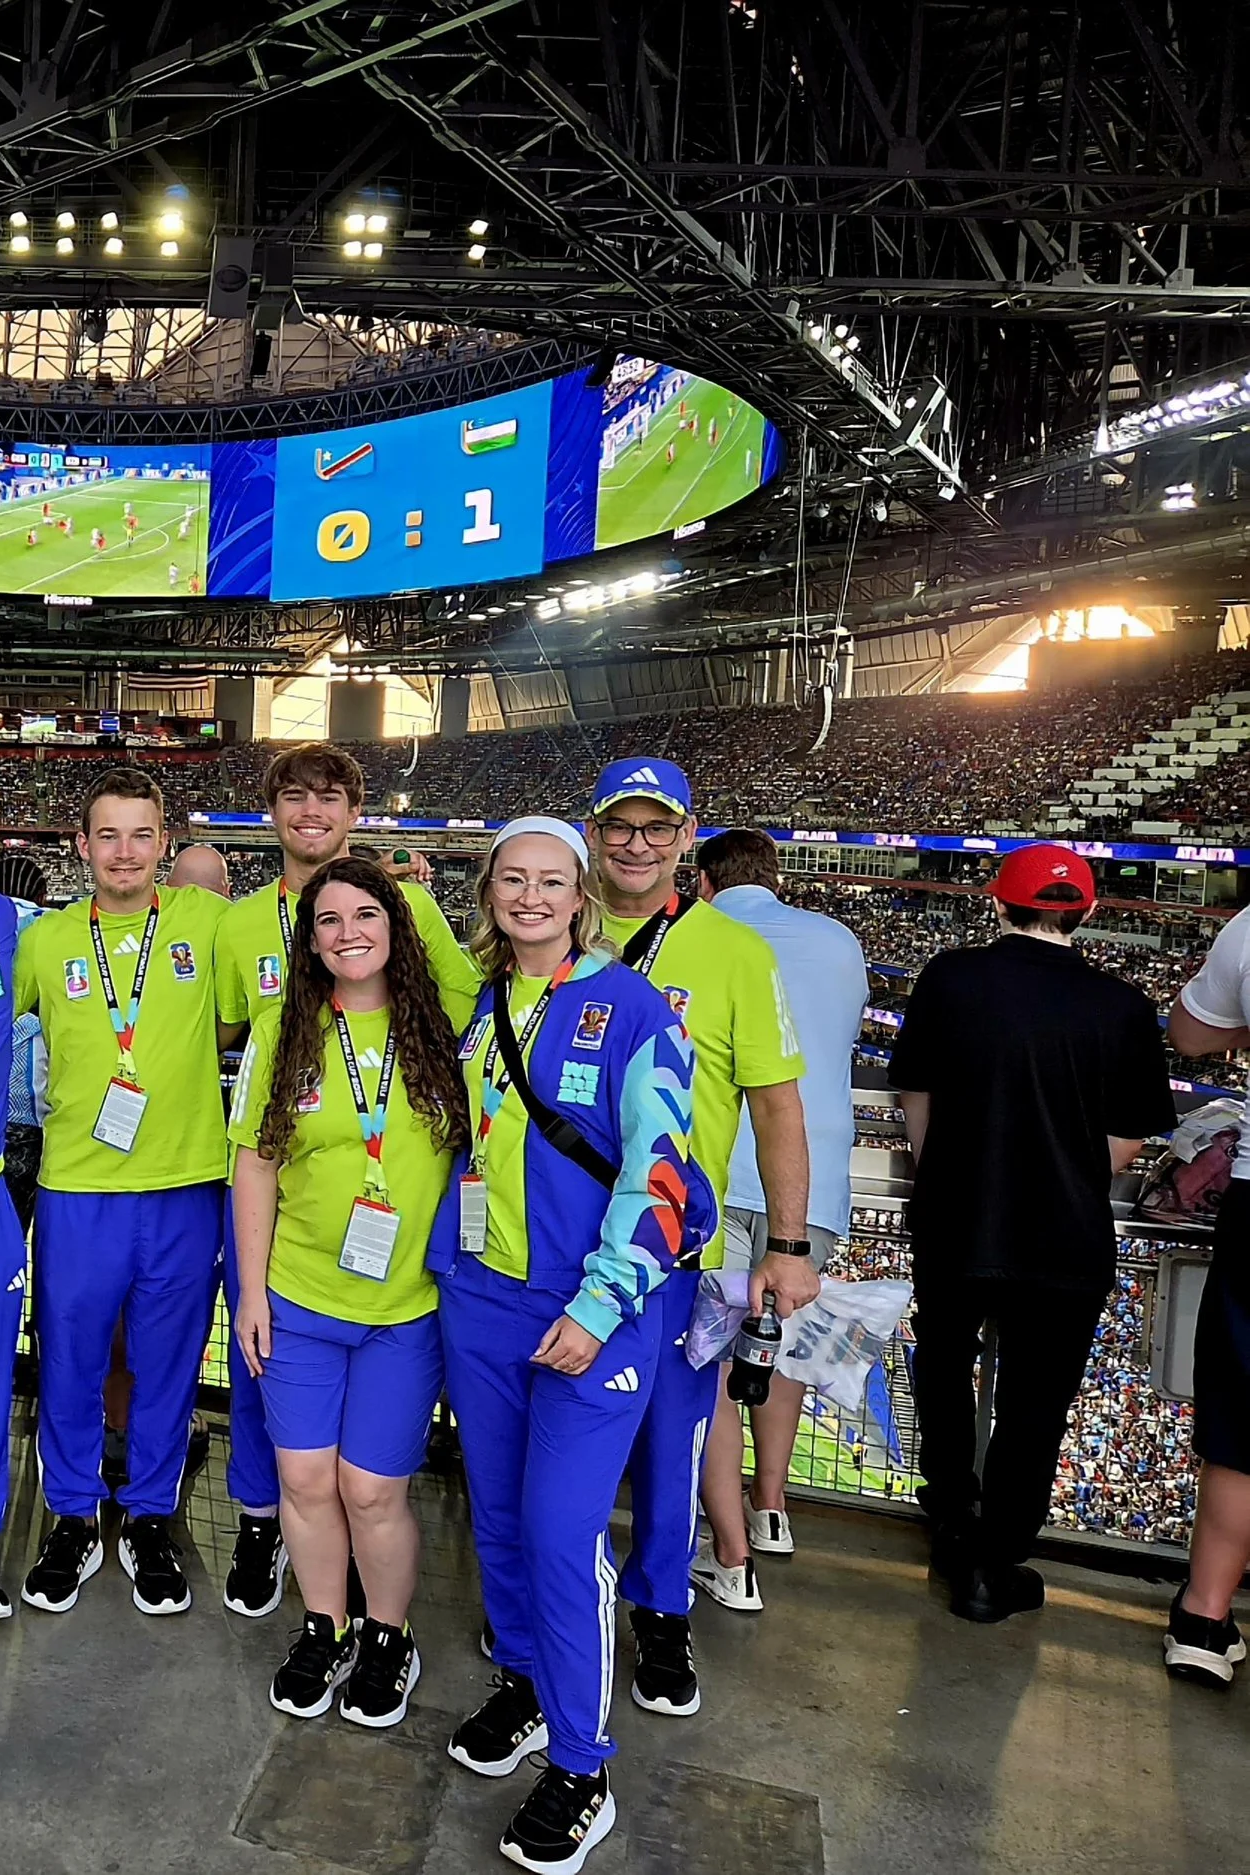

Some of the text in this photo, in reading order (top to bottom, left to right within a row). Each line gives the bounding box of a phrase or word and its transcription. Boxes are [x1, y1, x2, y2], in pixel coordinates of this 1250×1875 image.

[316, 509, 371, 562] 0
[462, 488, 501, 545] 1
[44, 594, 93, 606] Hisense
[792, 830, 838, 842] ATLANTA
[1175, 845, 1235, 863] ATLANTA
[658, 920, 669, 933] FIFA
[647, 933, 663, 959] WORLD
[138, 952, 148, 975] WORLD
[536, 995, 549, 1012] FIFA
[523, 1012, 540, 1041] WORLD
[337, 1017, 364, 1105] FIFA WORLD CUP 2026
[379, 1080, 389, 1097] FIFA
[384, 1054, 393, 1080] WORLD
